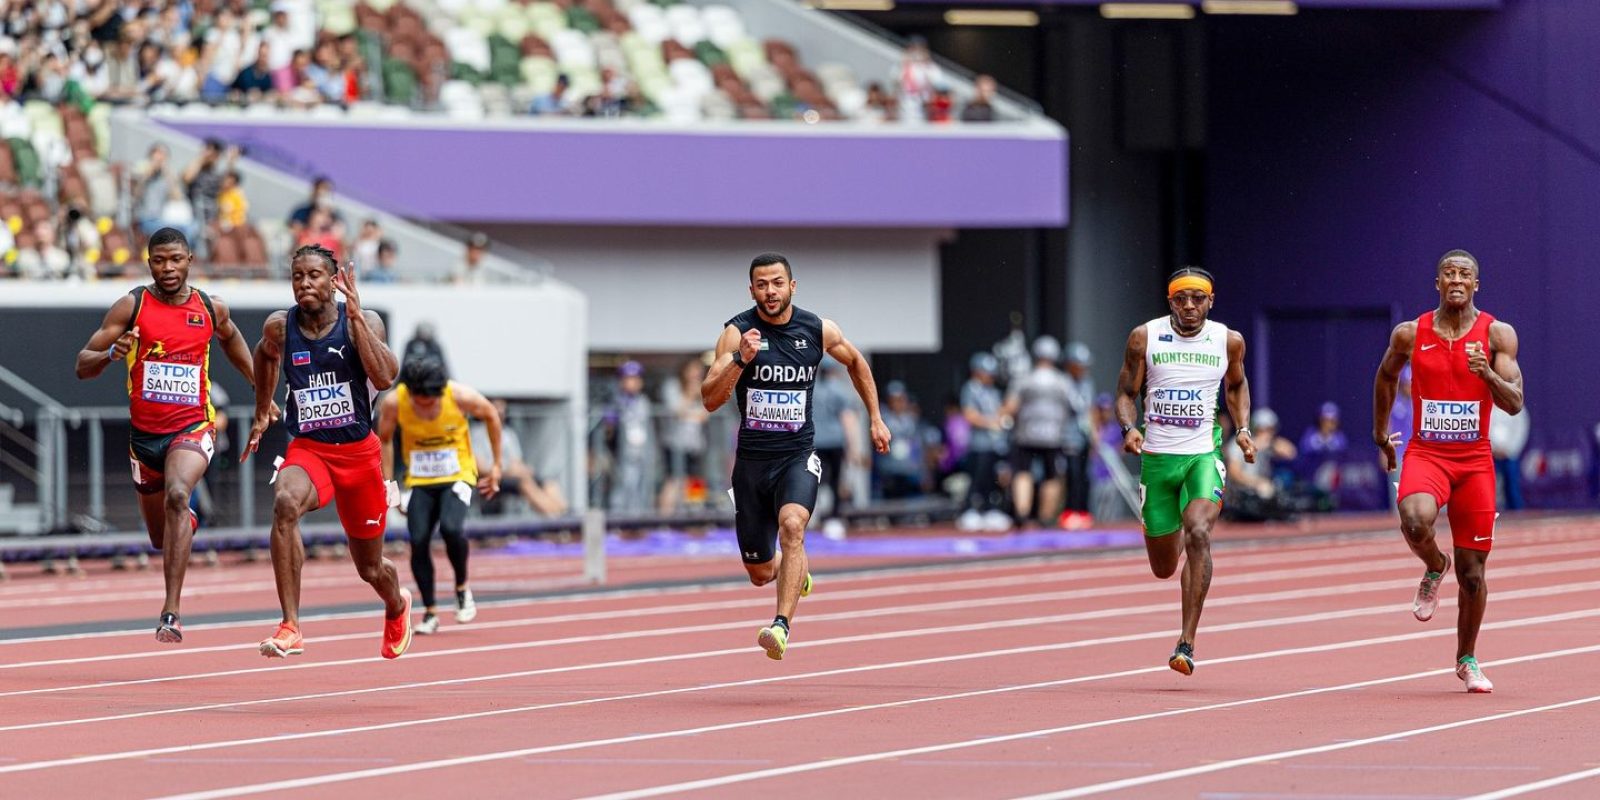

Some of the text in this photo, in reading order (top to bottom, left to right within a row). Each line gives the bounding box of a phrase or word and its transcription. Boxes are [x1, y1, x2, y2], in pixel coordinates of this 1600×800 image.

[1152, 351, 1221, 368] MONTSERRAT
[161, 364, 196, 379] TDK
[752, 365, 816, 382] JORDAN
[147, 378, 197, 394] SANTOS
[309, 371, 336, 388] HAITI
[306, 385, 346, 402] TDK
[764, 392, 802, 405] TDK
[1165, 389, 1202, 401] TDK
[300, 400, 351, 421] BORZOR
[749, 406, 803, 421] AL-AWAMLEH
[1153, 402, 1204, 416] WEEKES
[1437, 402, 1475, 415] TDK
[1424, 417, 1477, 430] HUISDEN
